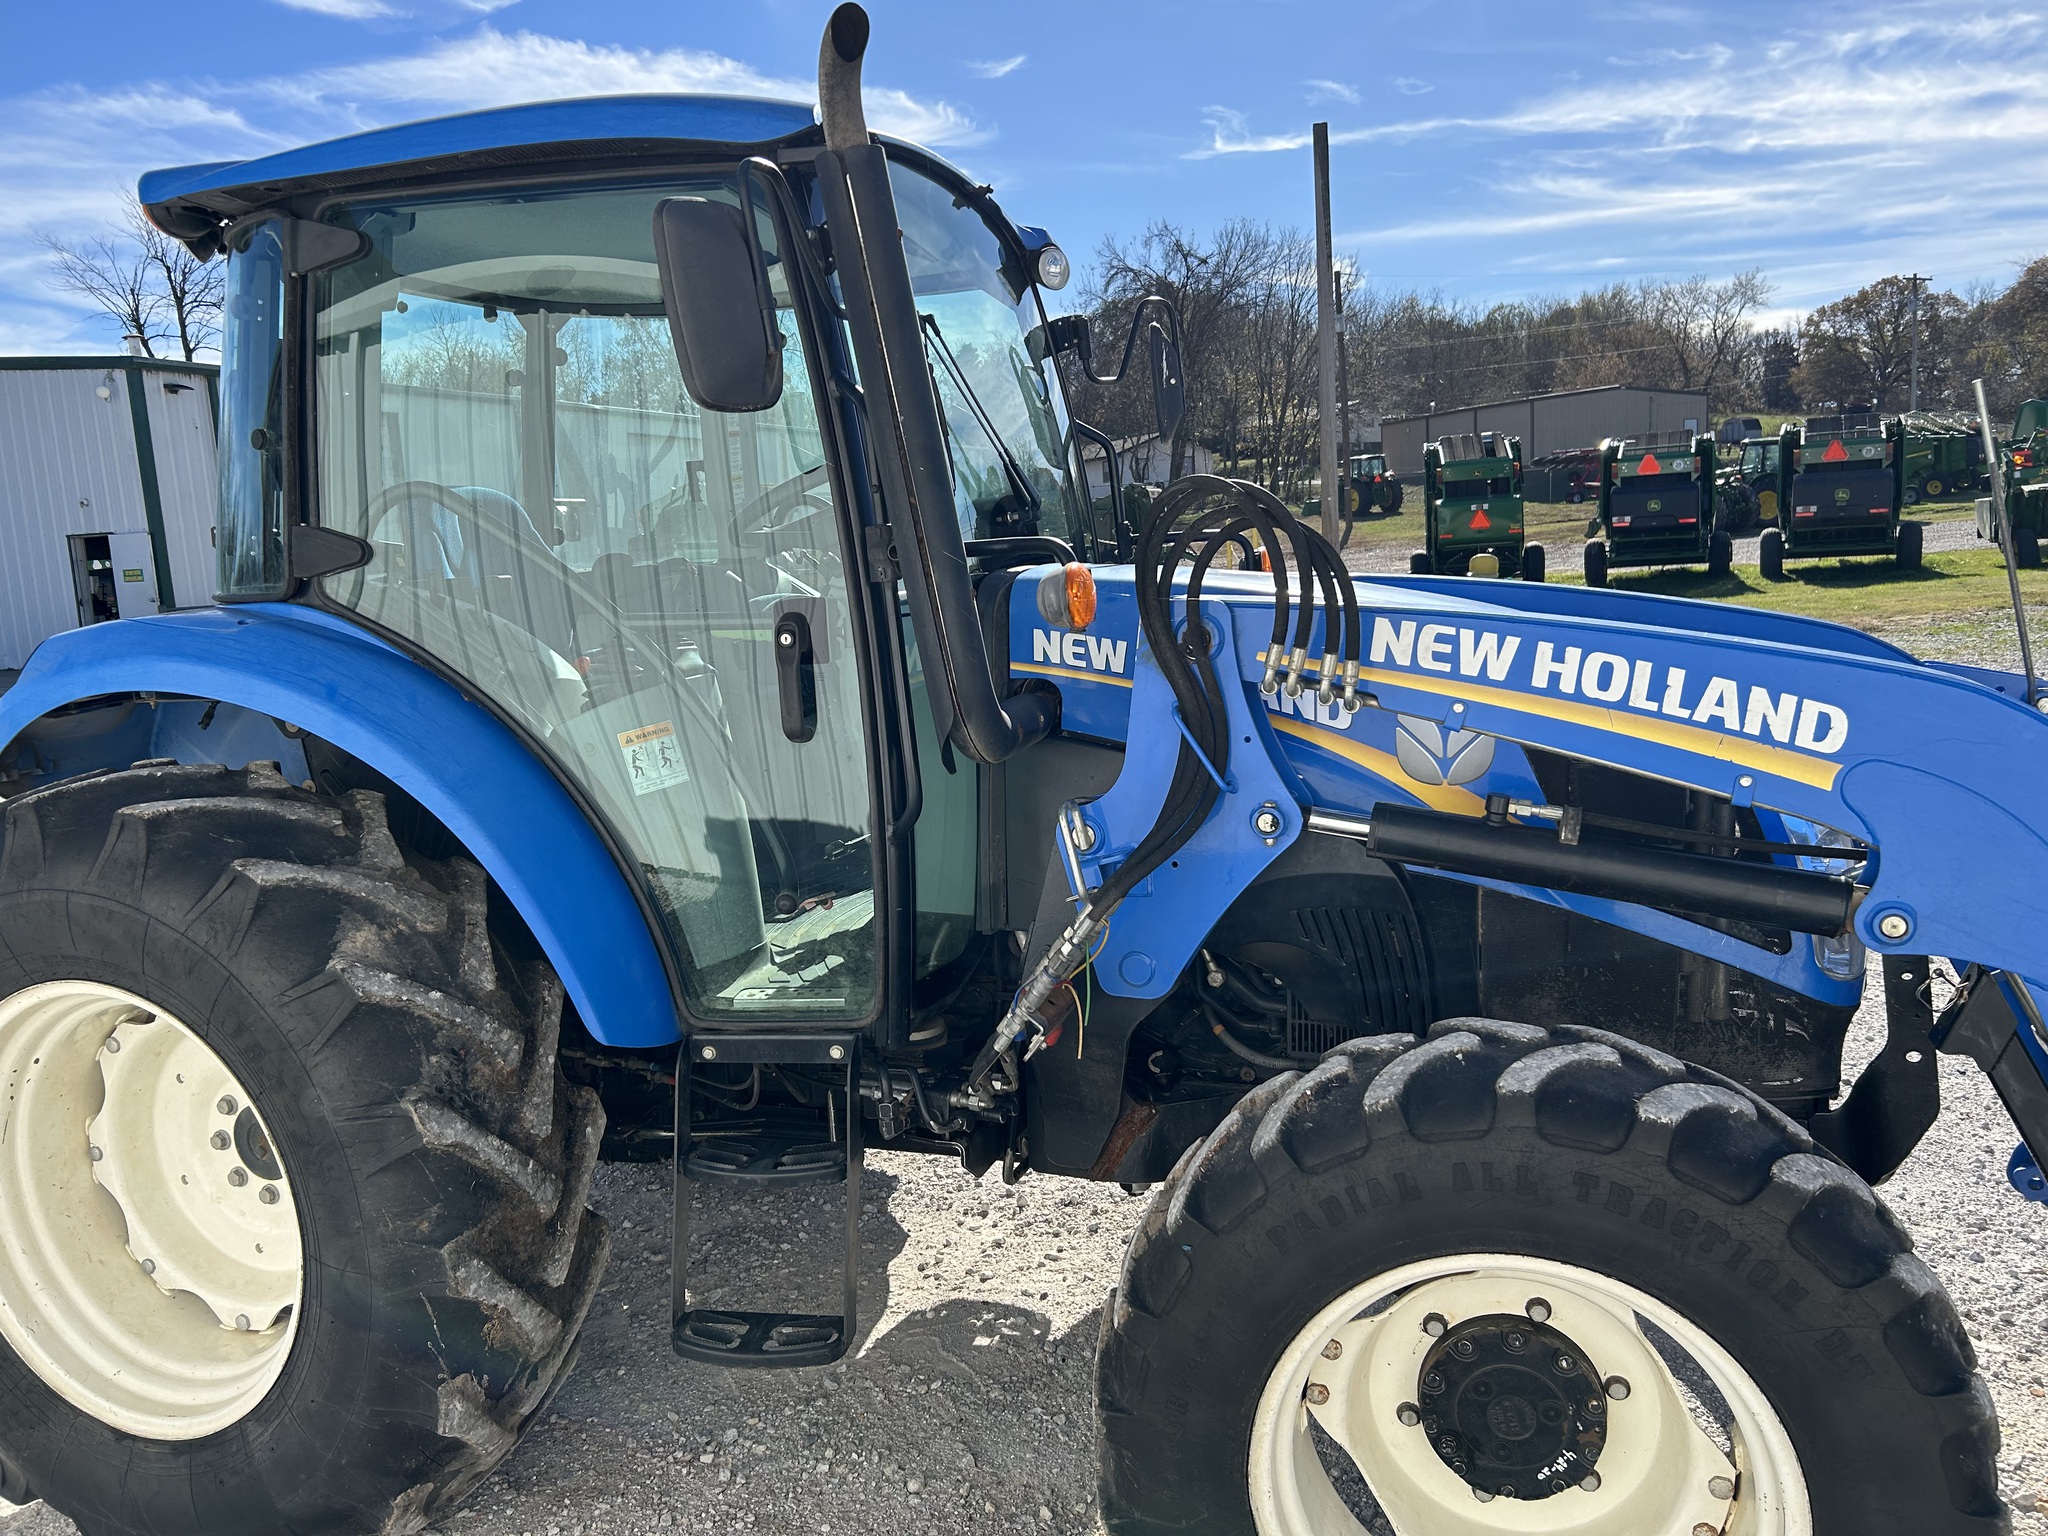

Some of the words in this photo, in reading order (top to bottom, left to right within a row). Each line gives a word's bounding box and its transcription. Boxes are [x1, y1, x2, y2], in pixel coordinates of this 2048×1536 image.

[1033, 628, 1127, 674] NEW
[1369, 616, 1521, 681] NEW
[1531, 642, 1849, 754] HOLLAND
[635, 726, 670, 741] WARNING
[1266, 1173, 1422, 1255] RADIAL
[1452, 1162, 1538, 1196] ALL
[1573, 1171, 1810, 1312] TRACTION
[1814, 1328, 1874, 1382] DT
